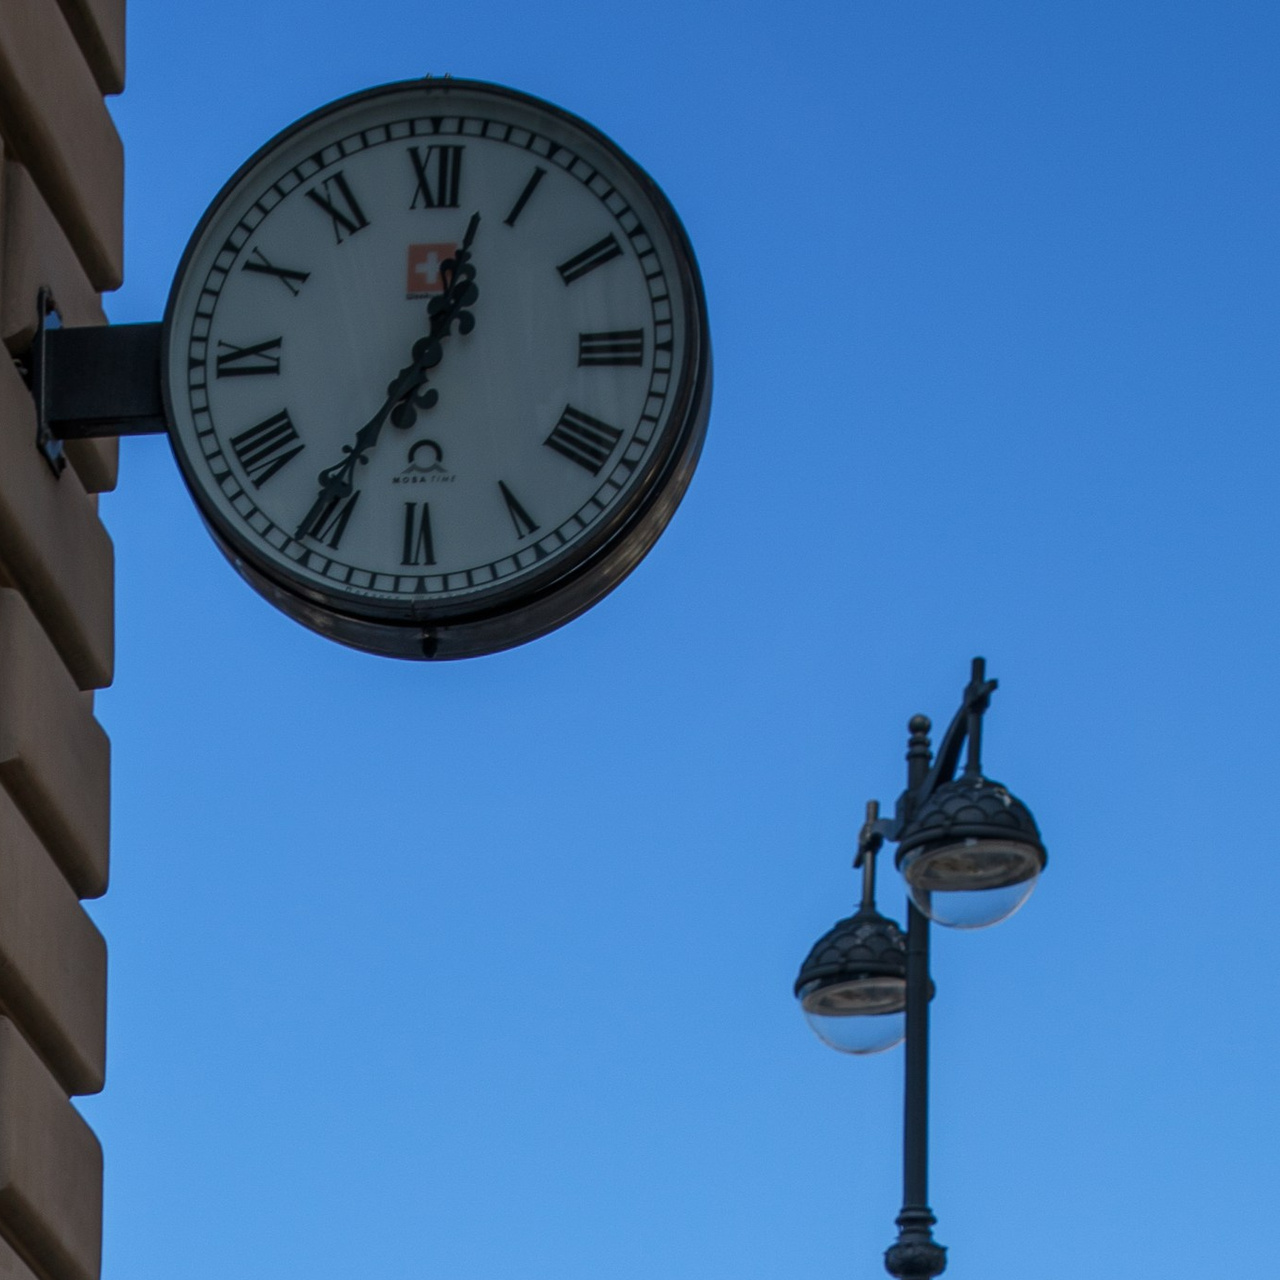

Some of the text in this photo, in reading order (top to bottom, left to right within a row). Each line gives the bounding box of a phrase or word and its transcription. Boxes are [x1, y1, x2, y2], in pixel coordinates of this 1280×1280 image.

[304, 170, 371, 245] XI
[406, 144, 466, 210] XII
[503, 165, 548, 228] I
[241, 245, 312, 297] X
[555, 231, 625, 288] II
[216, 336, 283, 380] IX
[577, 328, 645, 368] III
[229, 407, 306, 491] VIII
[542, 403, 625, 478] IIII
[392, 474, 457, 484] MOBA TIME
[498, 479, 541, 541] V
[400, 501, 437, 566] VI
